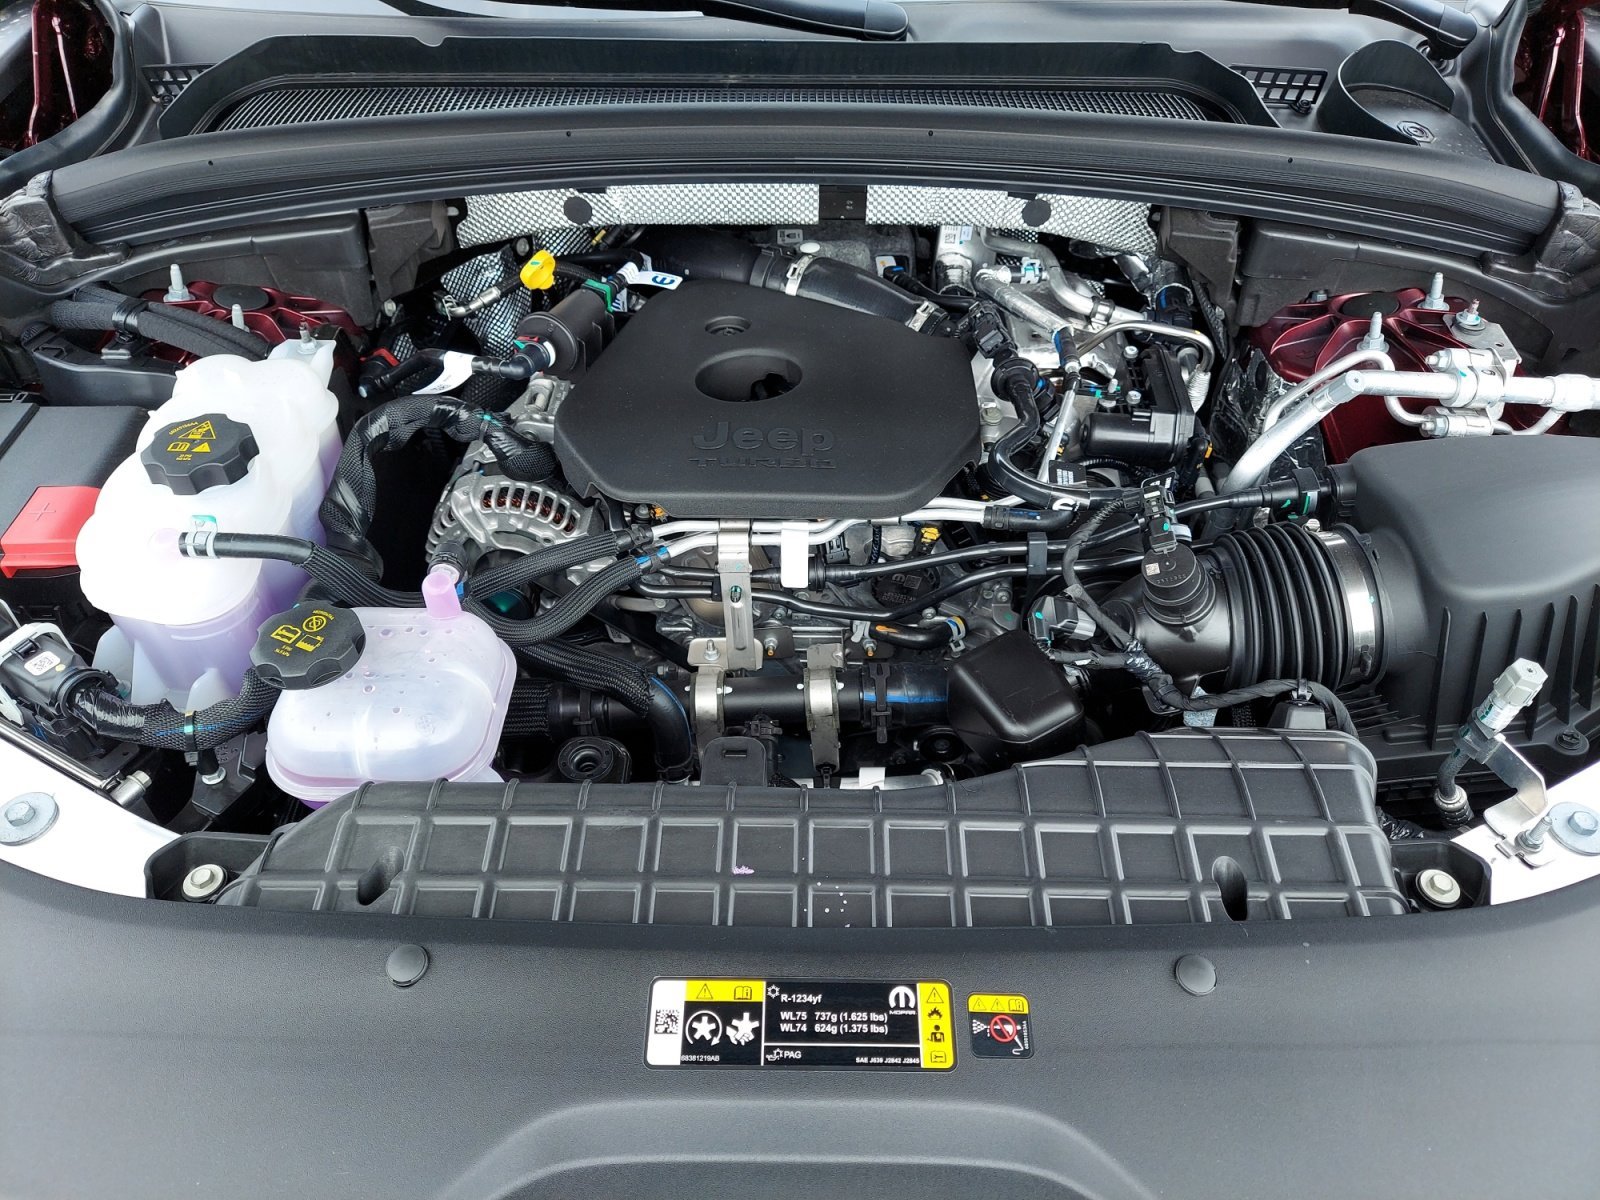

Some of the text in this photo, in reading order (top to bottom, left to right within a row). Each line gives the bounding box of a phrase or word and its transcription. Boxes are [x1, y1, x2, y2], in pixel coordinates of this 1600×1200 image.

[693, 421, 835, 456] Jeep
[688, 457, 837, 470] TURBO
[781, 994, 822, 1004] R-1234yf
[780, 1012, 888, 1023] WL75 737g (1.625 lbs)
[780, 1023, 889, 1035] WL74 624g (1.375 lbs)
[784, 1050, 802, 1059] PAG
